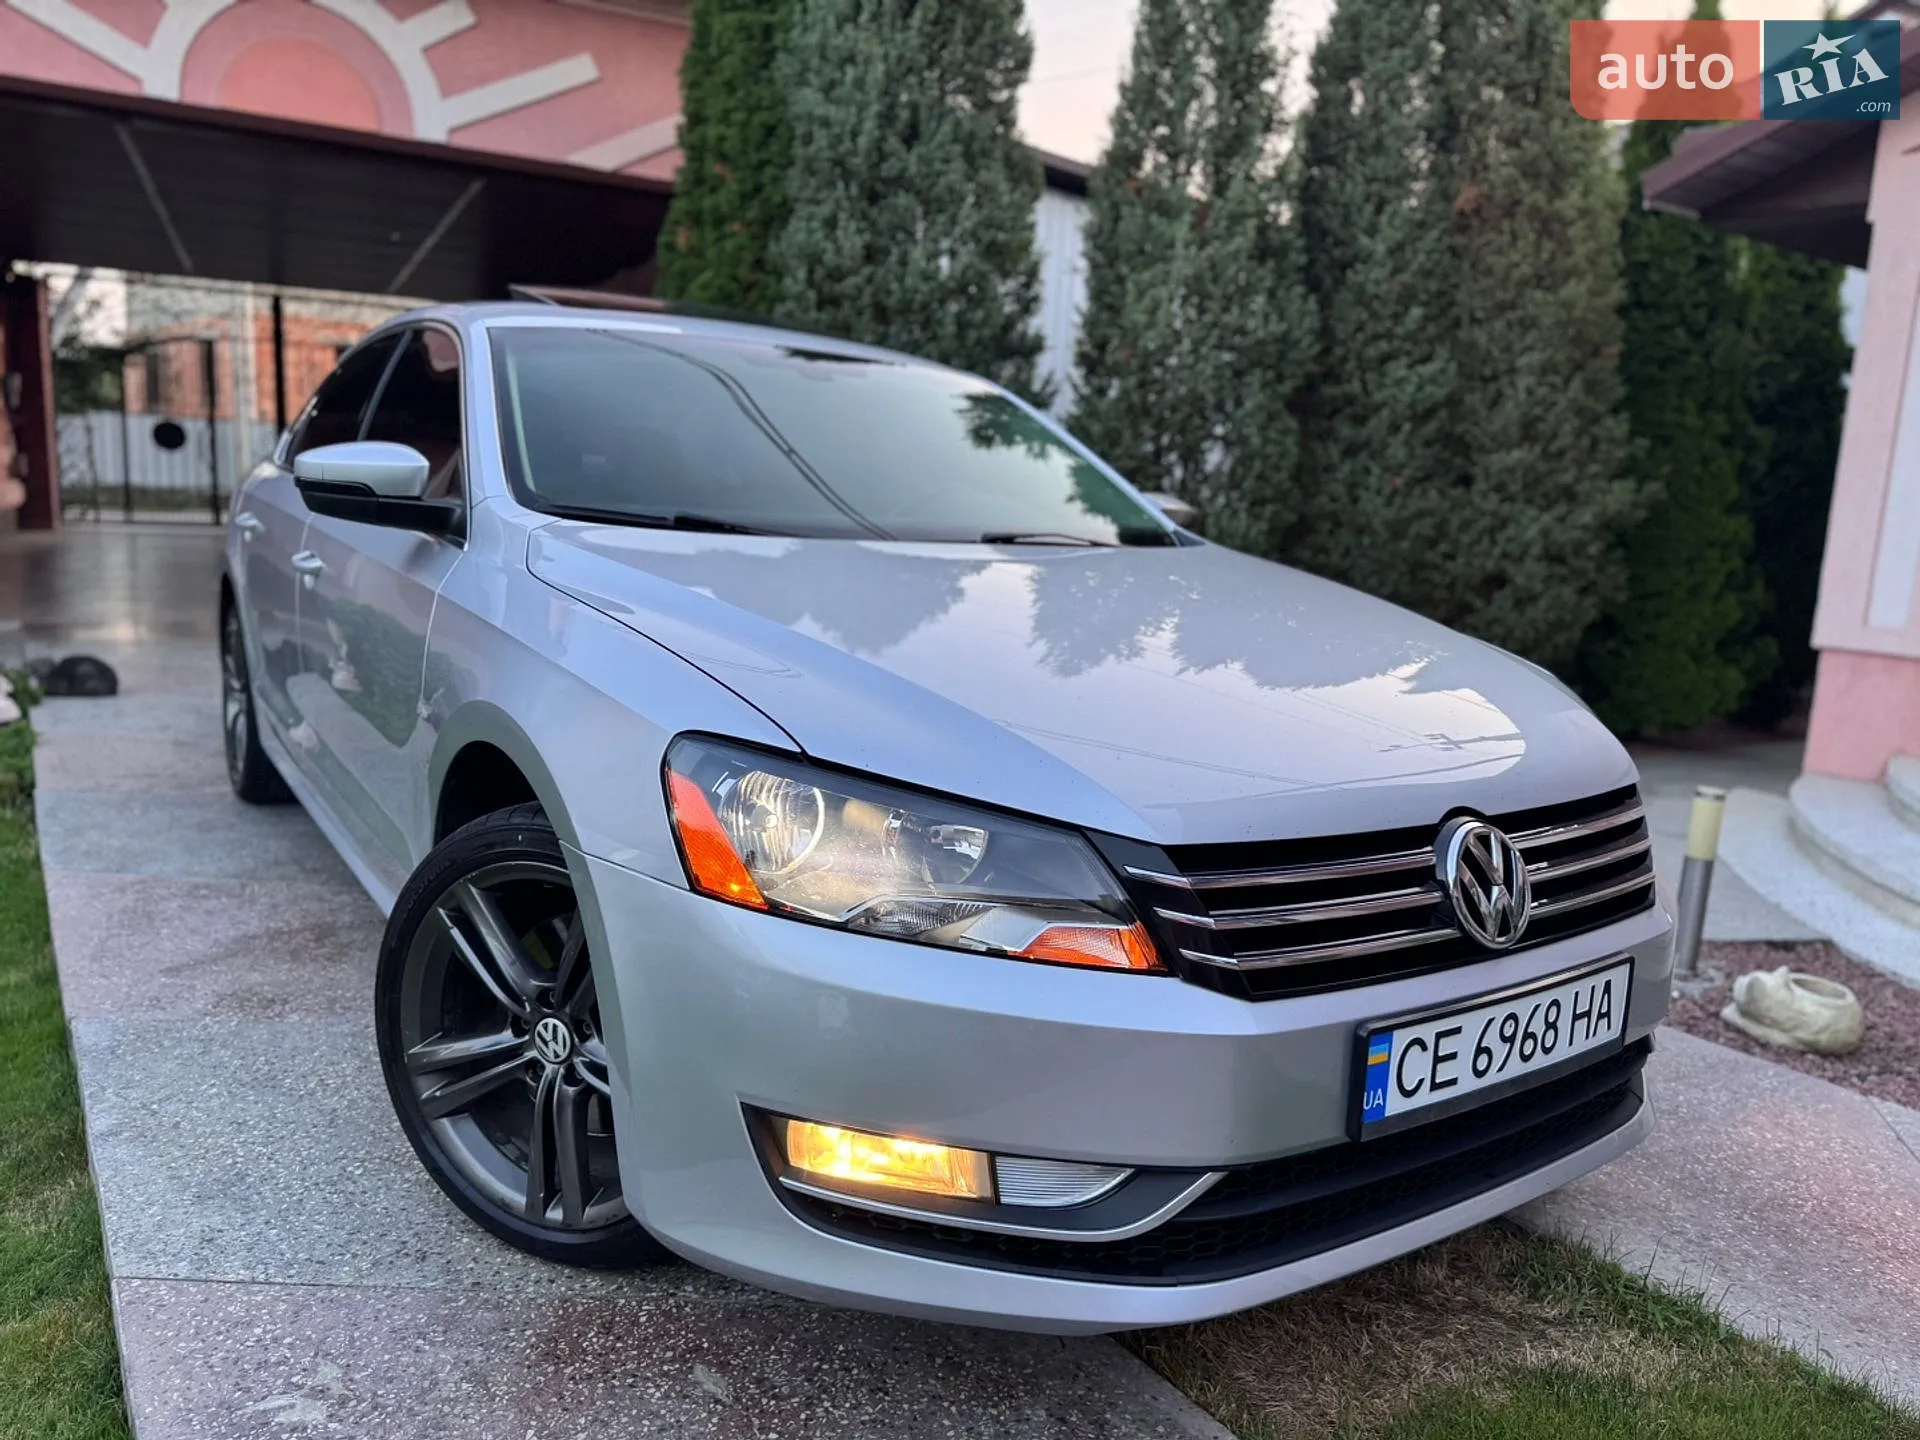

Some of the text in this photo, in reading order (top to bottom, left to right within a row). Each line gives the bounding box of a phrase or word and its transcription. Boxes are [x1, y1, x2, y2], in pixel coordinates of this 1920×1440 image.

[1396, 978, 1613, 1099] CE 6968 HA
[1362, 1087, 1385, 1111] UA
